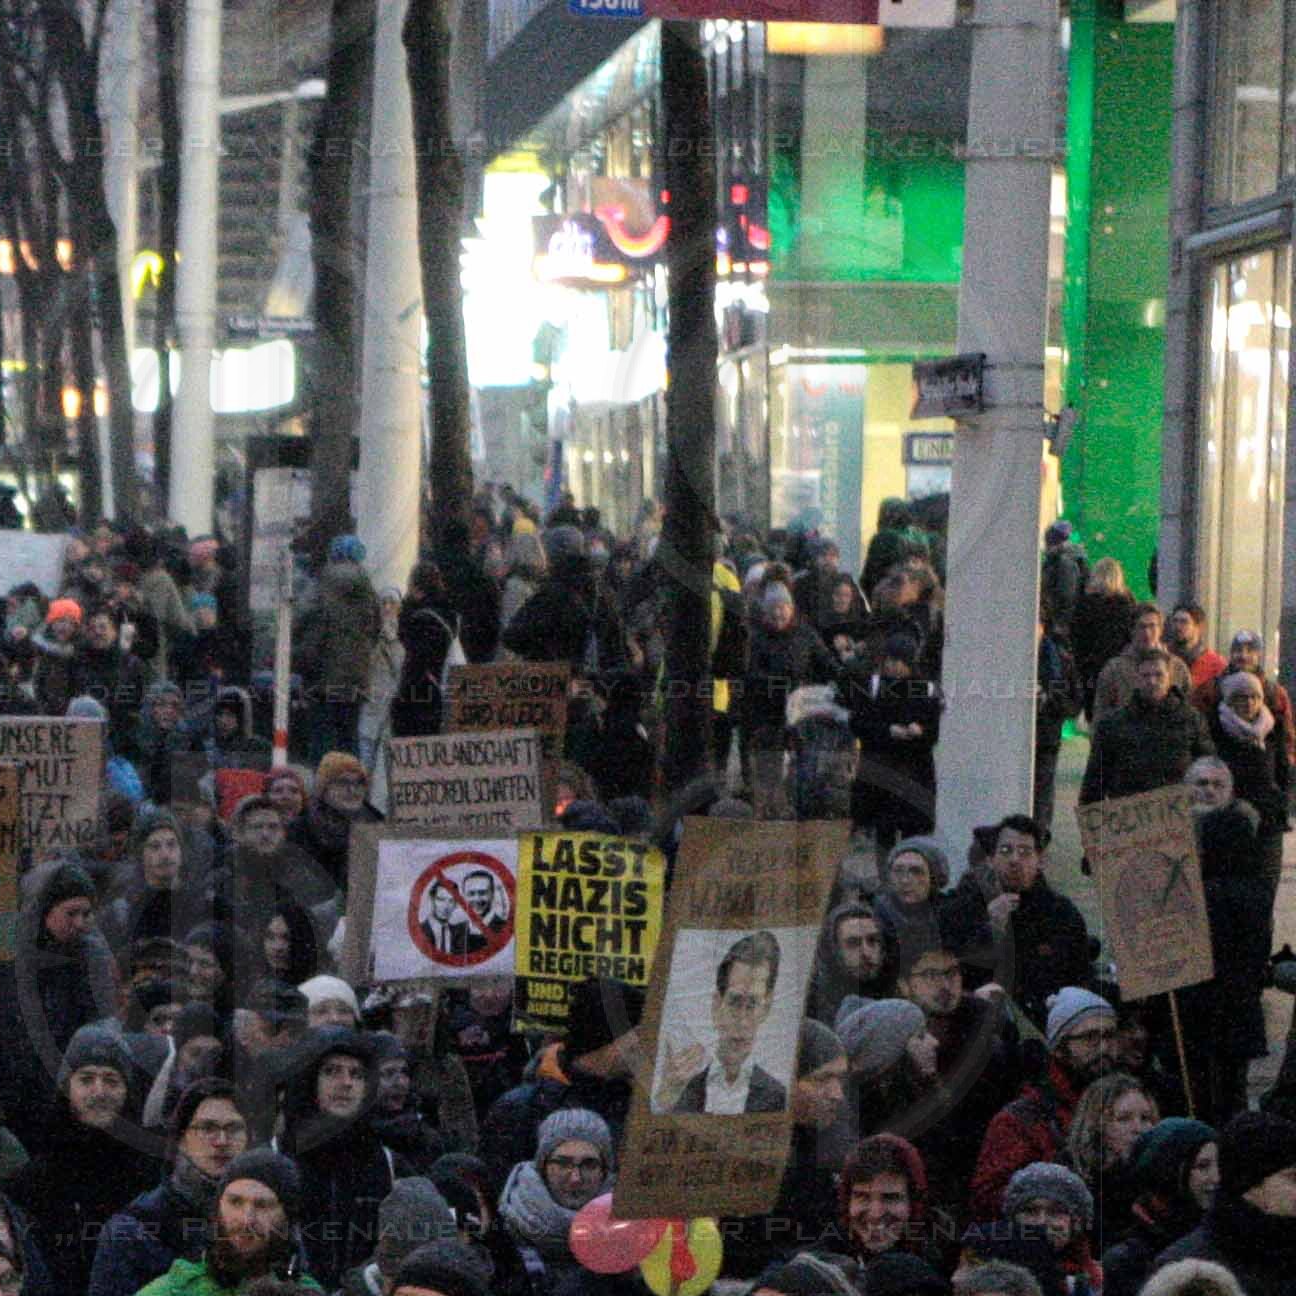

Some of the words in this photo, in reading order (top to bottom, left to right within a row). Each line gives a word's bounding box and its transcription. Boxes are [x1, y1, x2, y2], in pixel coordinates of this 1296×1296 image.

[531, 835, 648, 878] LASST
[531, 875, 648, 917] NAZIS
[530, 912, 648, 954] NICHT
[529, 950, 646, 981] REGIEREN
